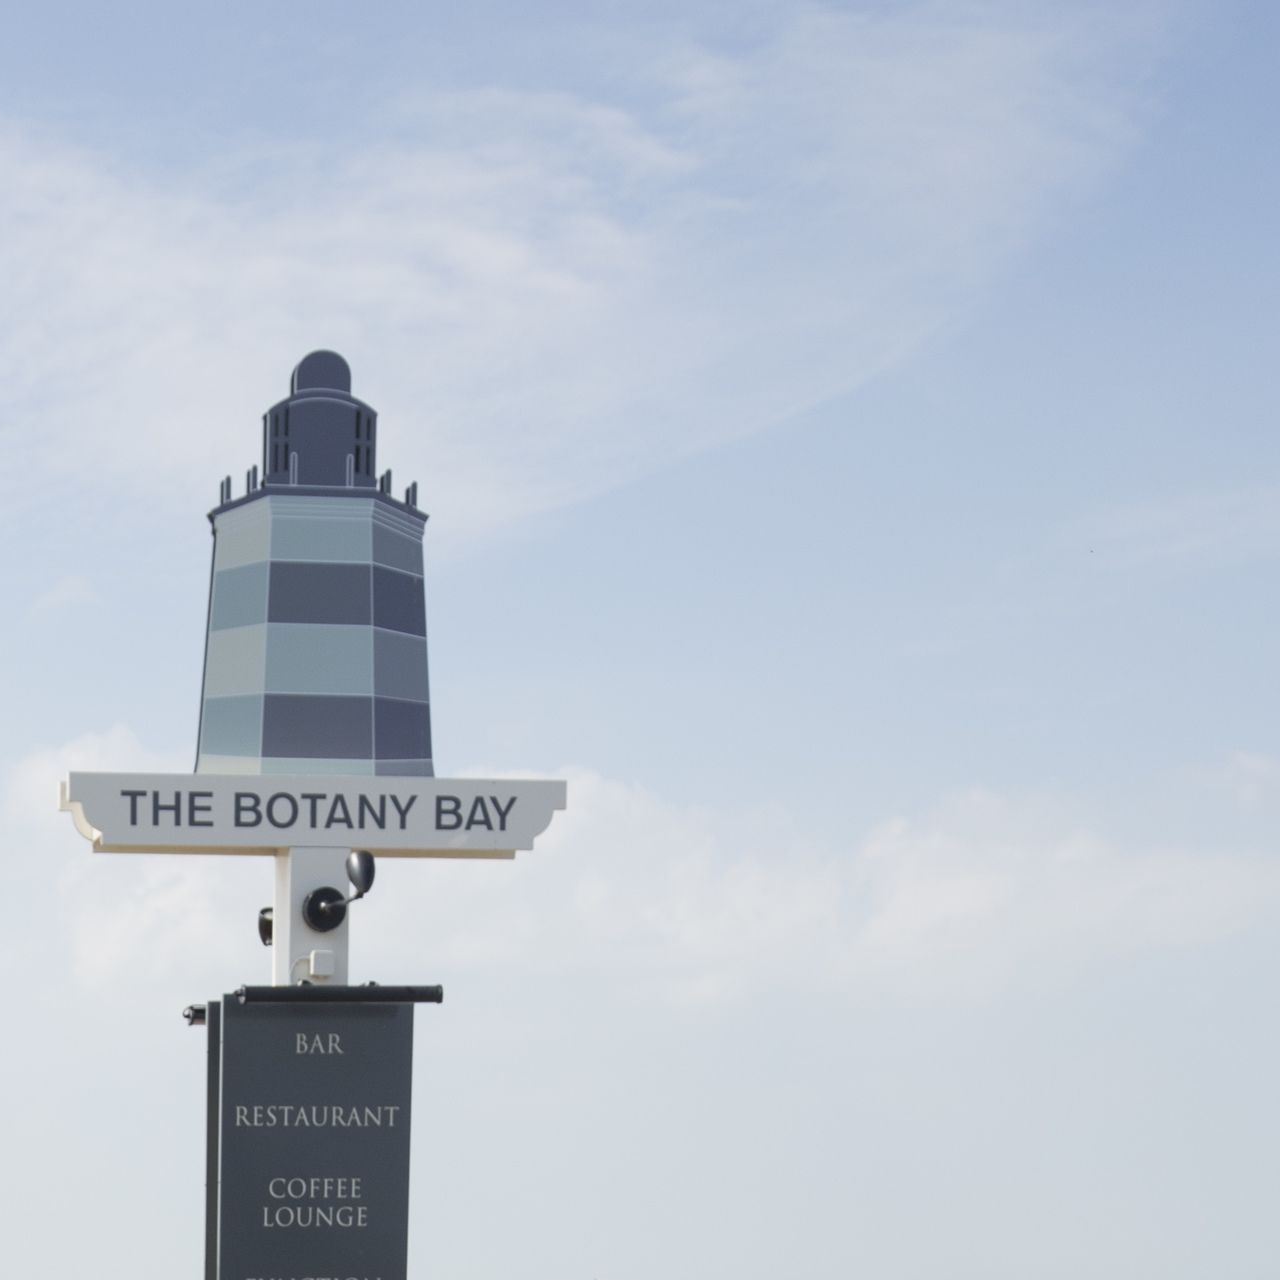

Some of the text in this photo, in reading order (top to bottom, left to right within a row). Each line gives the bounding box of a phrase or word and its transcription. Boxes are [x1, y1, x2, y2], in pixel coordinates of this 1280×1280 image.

[121, 789, 518, 832] THE BOTANY BAY
[295, 1032, 344, 1055] BAR
[235, 1105, 400, 1127] RESTAURANT
[268, 1177, 362, 1199] COFFEE
[263, 1206, 368, 1228] LOUNGE
